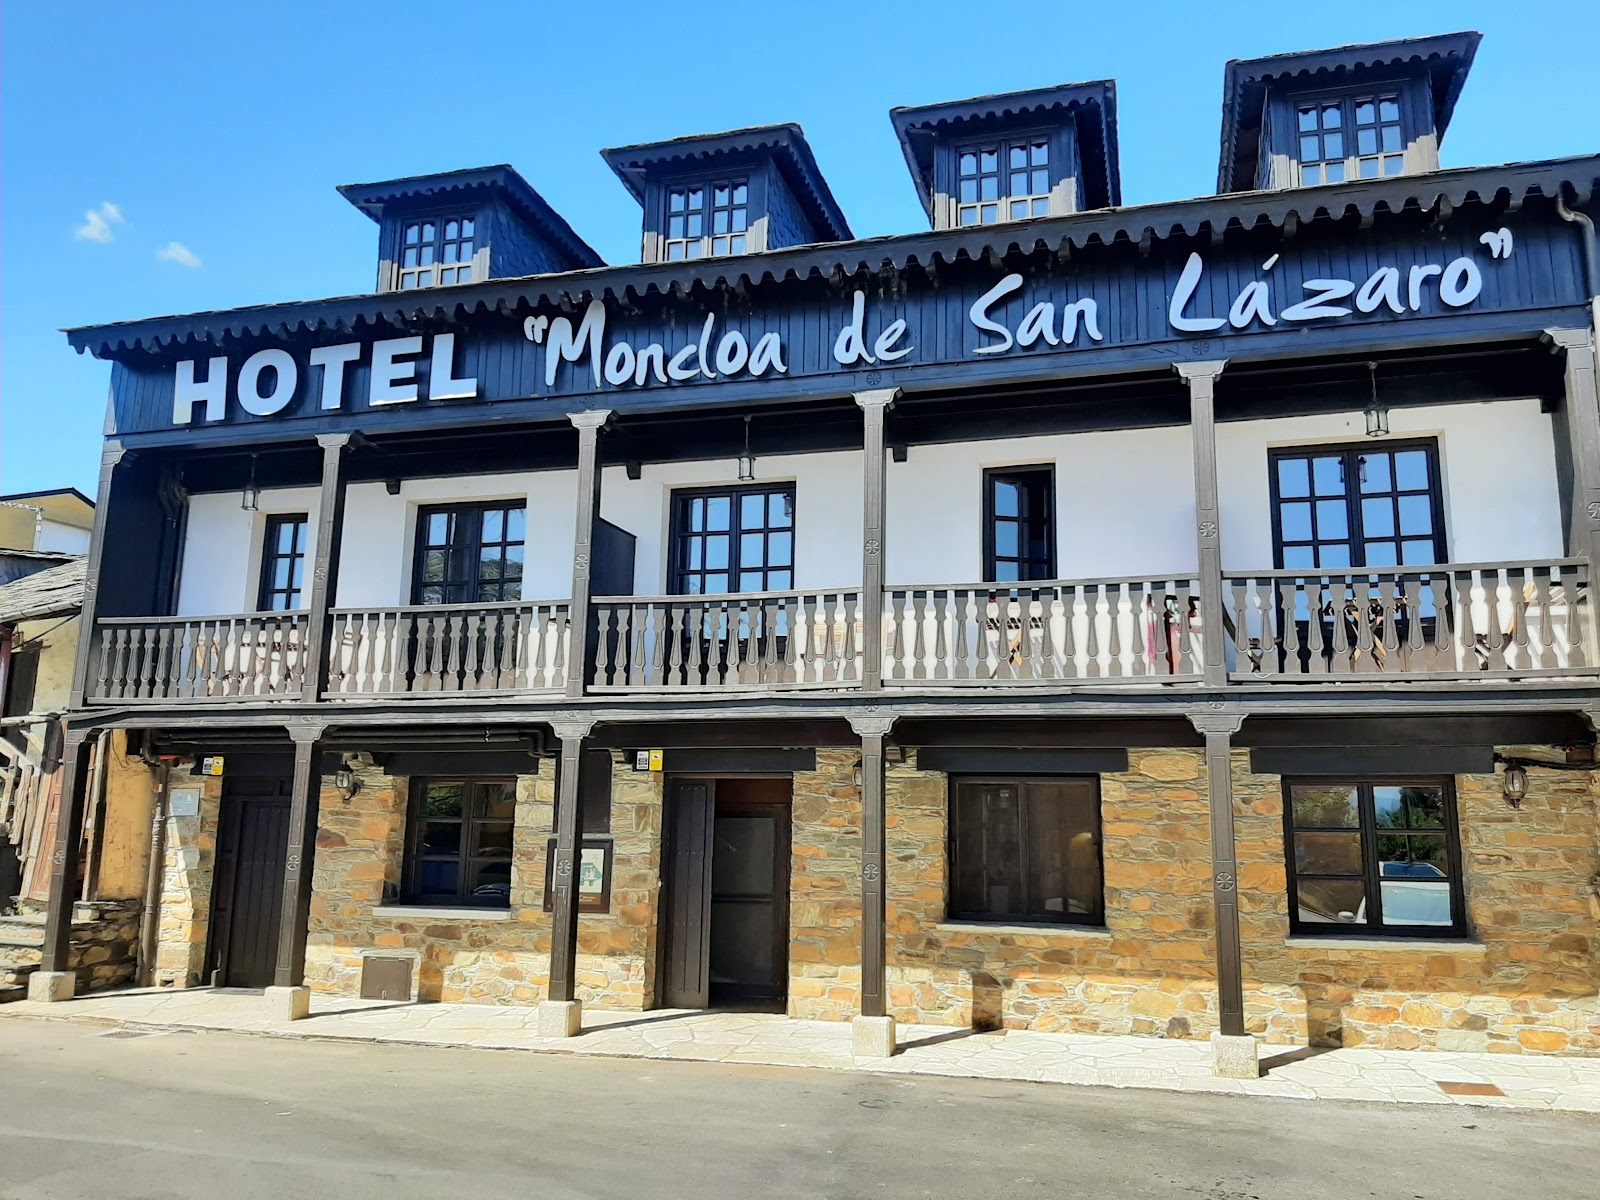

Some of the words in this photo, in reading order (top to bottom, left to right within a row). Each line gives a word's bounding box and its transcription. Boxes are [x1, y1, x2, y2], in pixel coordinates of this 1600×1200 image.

[172, 333, 478, 425] HOTEL
[523, 299, 788, 387] "Moncloa
[834, 290, 915, 364] de
[969, 273, 1103, 354] San
